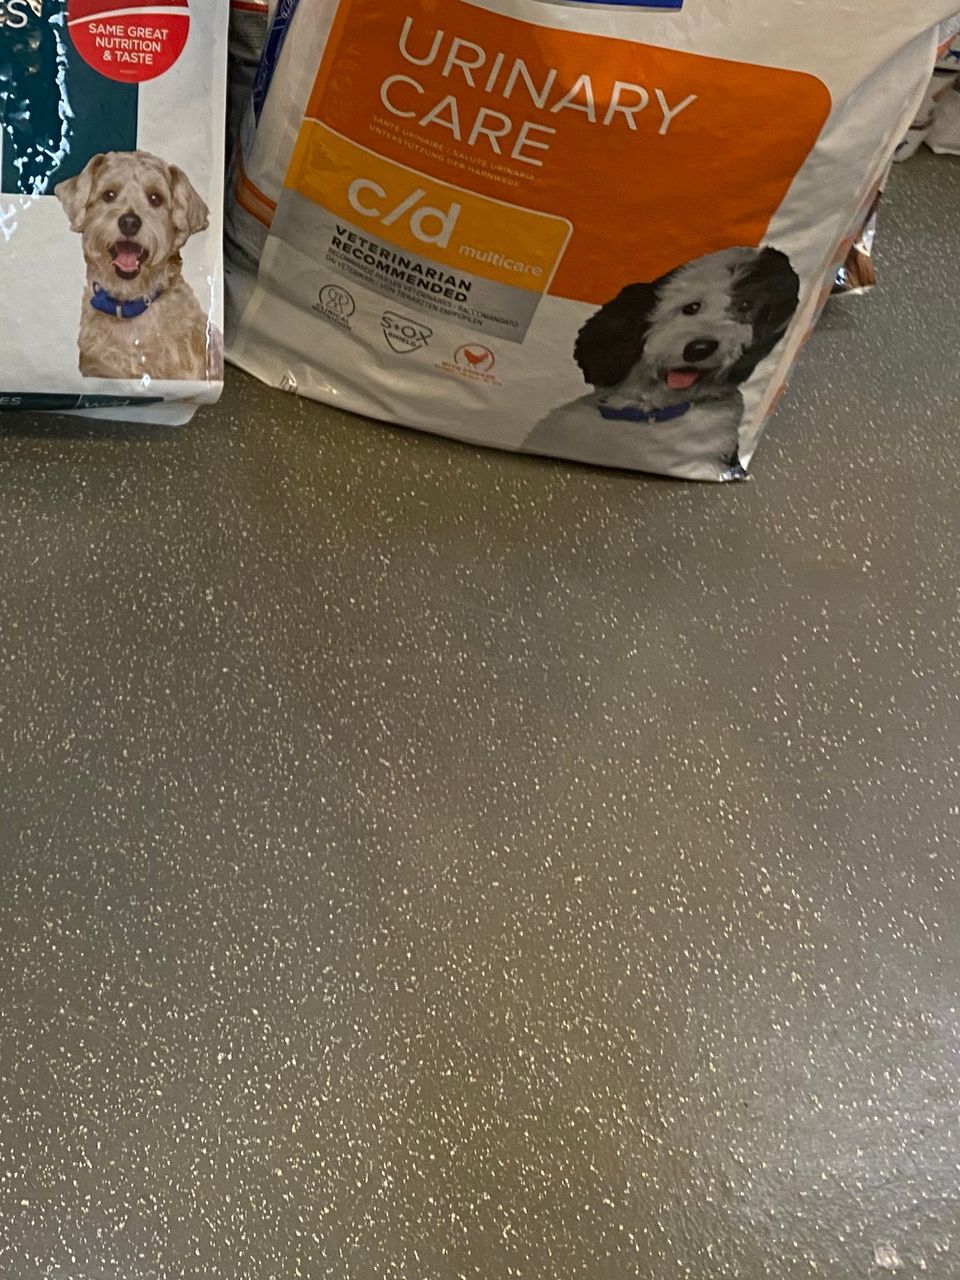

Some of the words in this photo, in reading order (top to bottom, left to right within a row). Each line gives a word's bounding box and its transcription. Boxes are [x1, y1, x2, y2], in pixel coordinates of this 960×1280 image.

[88, 23, 125, 37] SAME
[127, 26, 169, 41] GREAT
[95, 36, 161, 53] NUTRITION
[102, 50, 112, 61] &
[115, 51, 154, 66] TASTE
[398, 16, 699, 136] URINARY
[380, 73, 557, 168] CARE
[348, 177, 462, 249] c/d
[331, 234, 468, 303] RECOMMENDED
[335, 224, 472, 293] VETERINARIAN
[459, 243, 544, 277] multicare
[380, 315, 432, 346] S+OX
